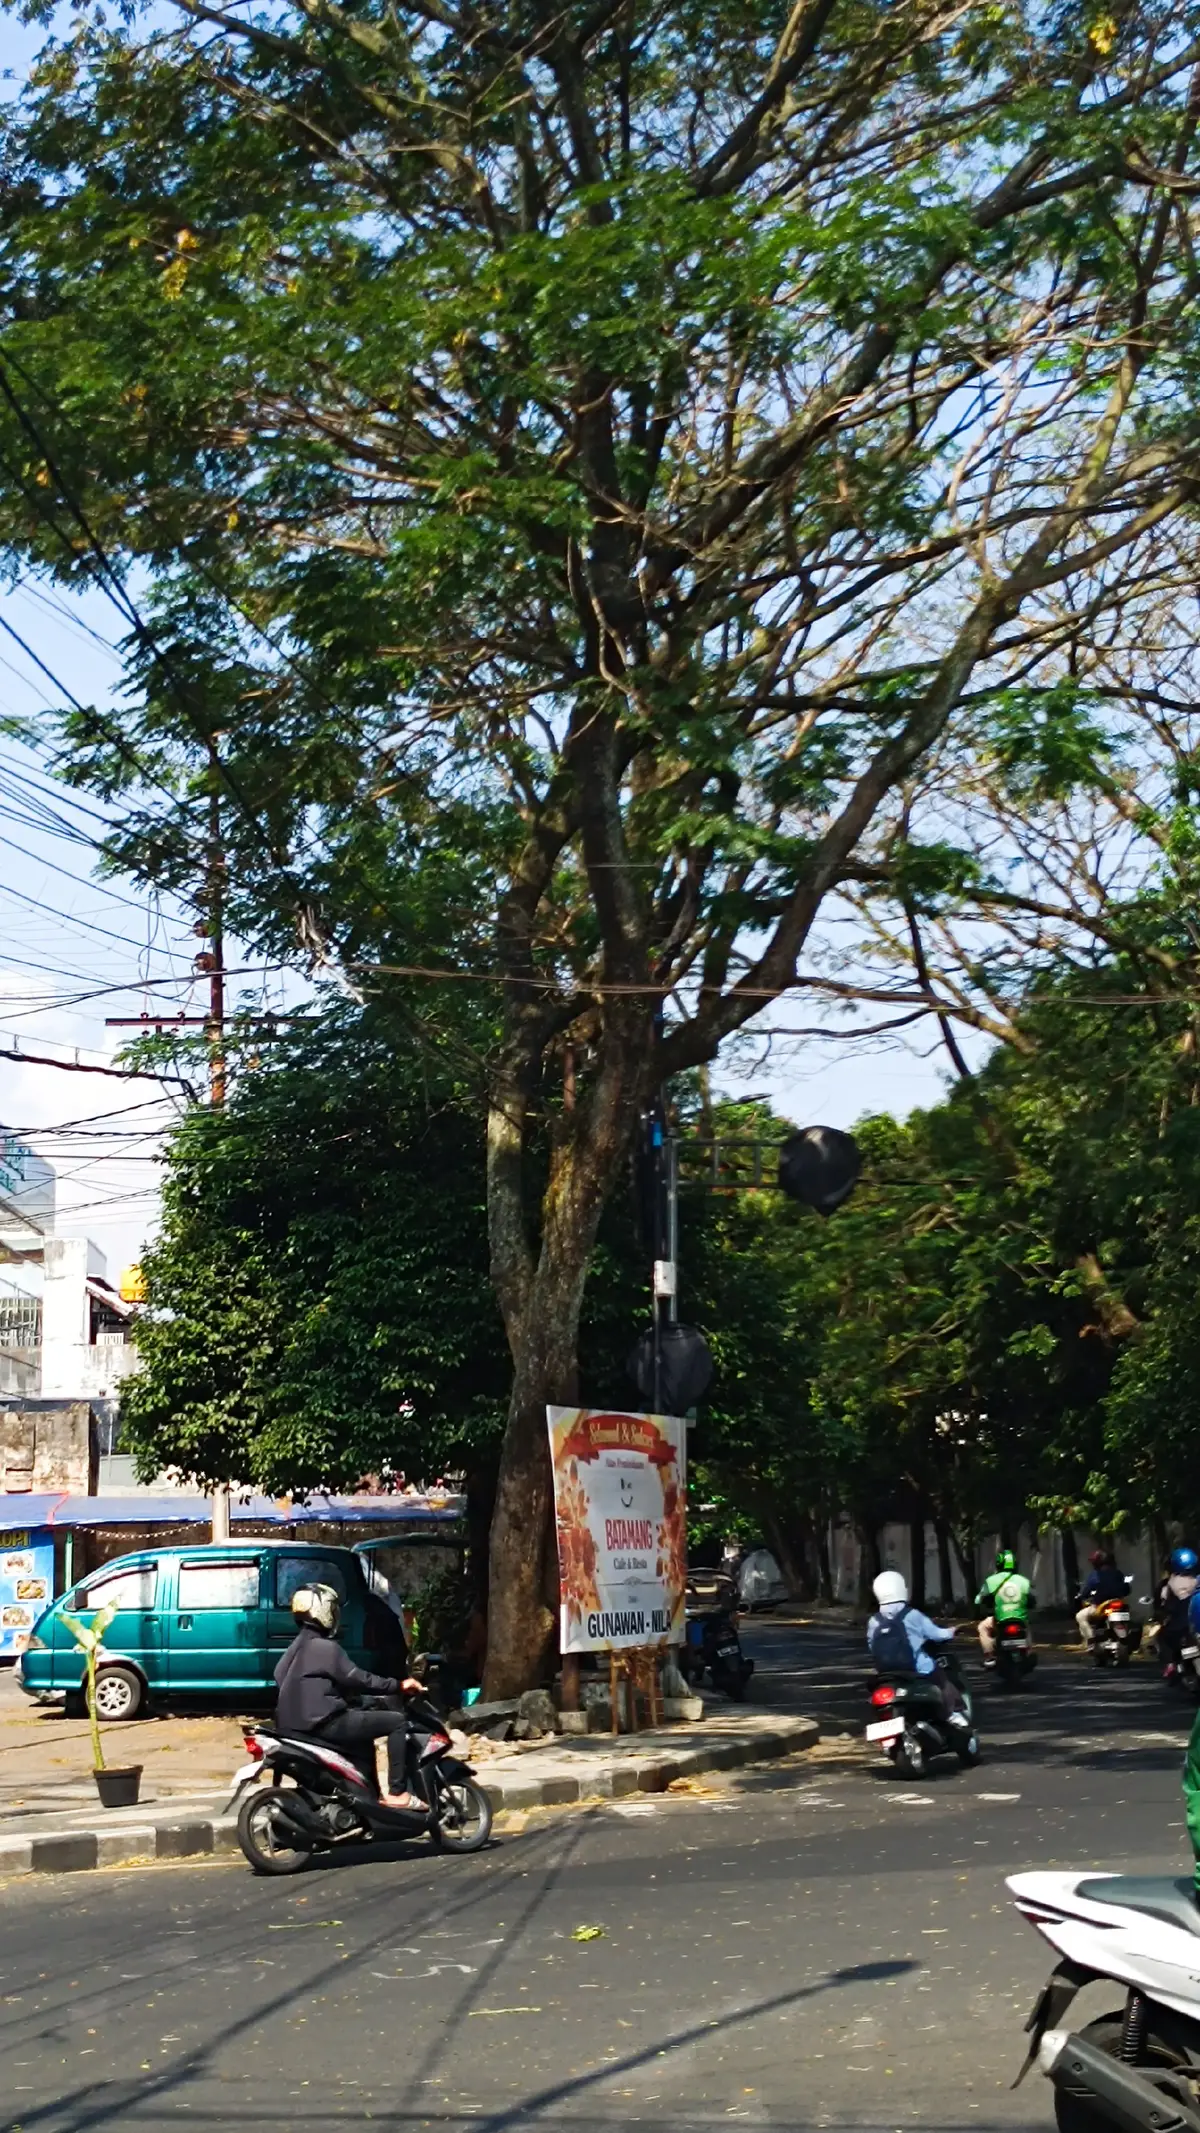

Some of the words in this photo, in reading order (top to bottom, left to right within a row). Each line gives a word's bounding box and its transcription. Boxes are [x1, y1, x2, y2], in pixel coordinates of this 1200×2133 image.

[605, 1519, 653, 1551] BATAMANG
[587, 1611, 645, 1638] GUNAWAN
[651, 1610, 672, 1633] NILA
